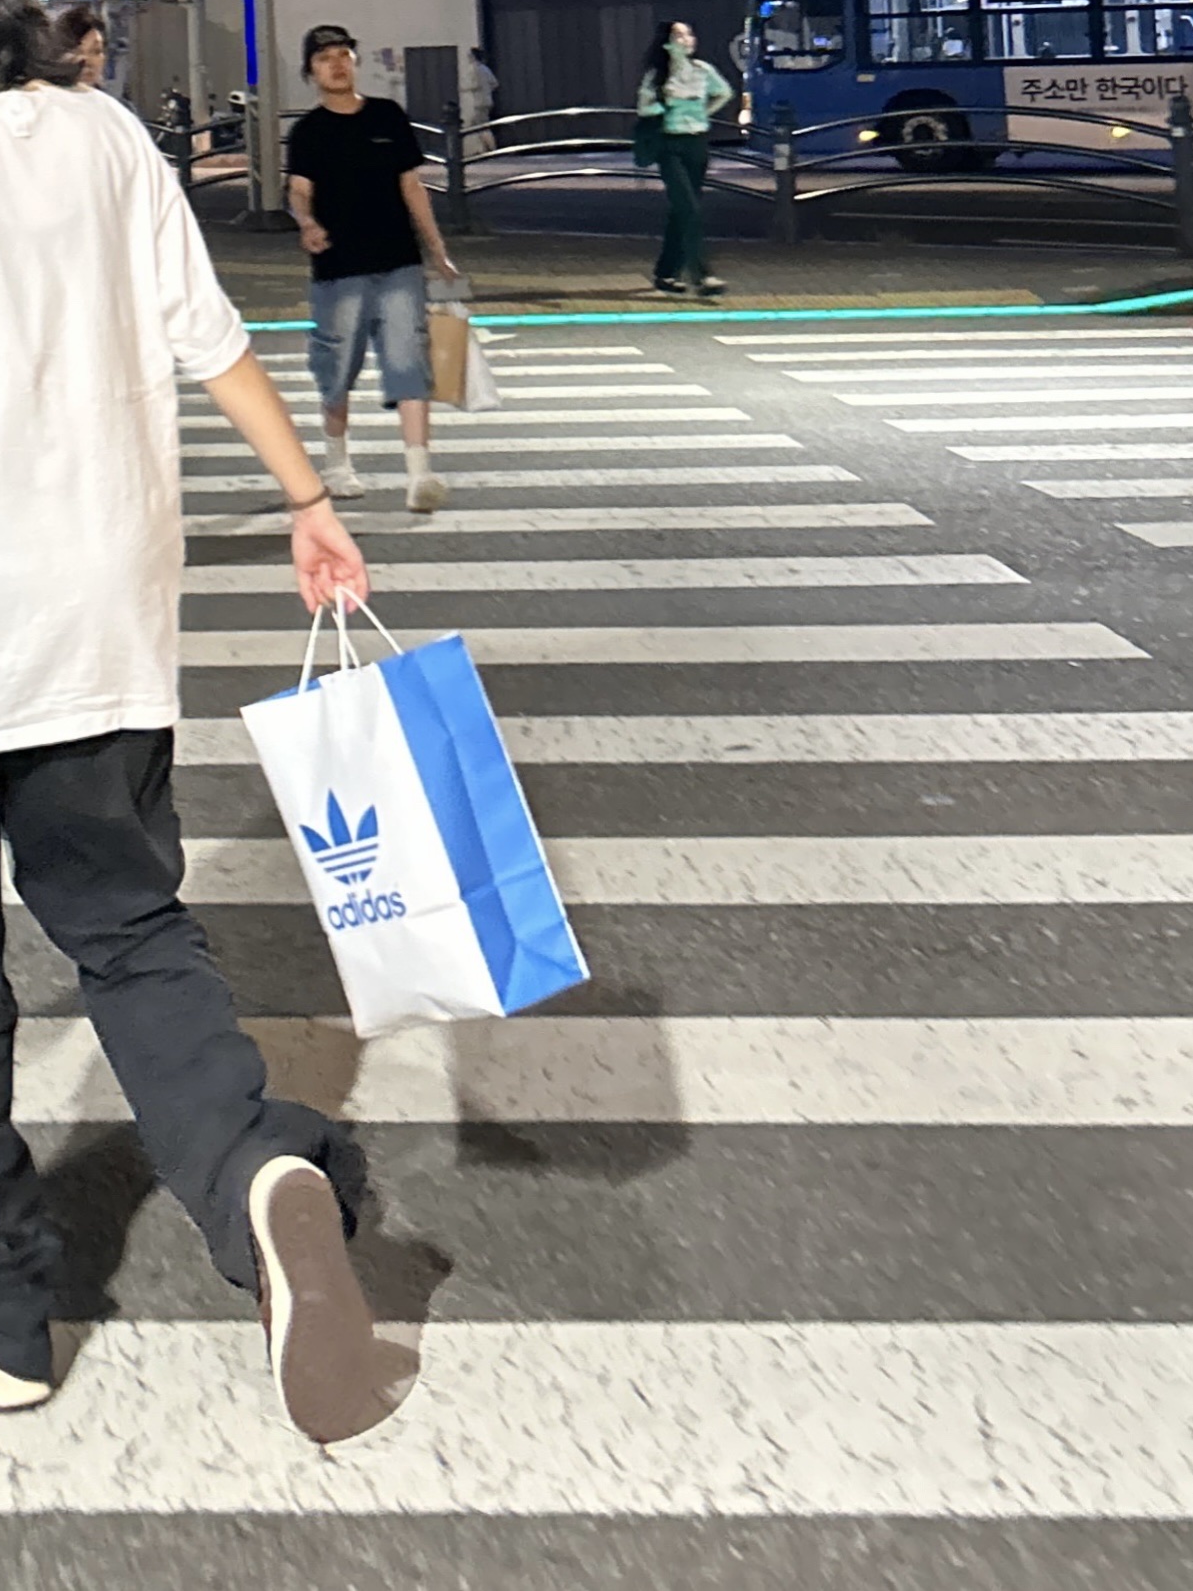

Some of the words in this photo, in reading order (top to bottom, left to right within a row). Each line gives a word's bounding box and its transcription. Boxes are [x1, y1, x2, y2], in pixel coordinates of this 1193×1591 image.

[1021, 76, 1090, 103] 주소만
[1094, 74, 1189, 101] 한국이다
[326, 886, 408, 932] adidas
